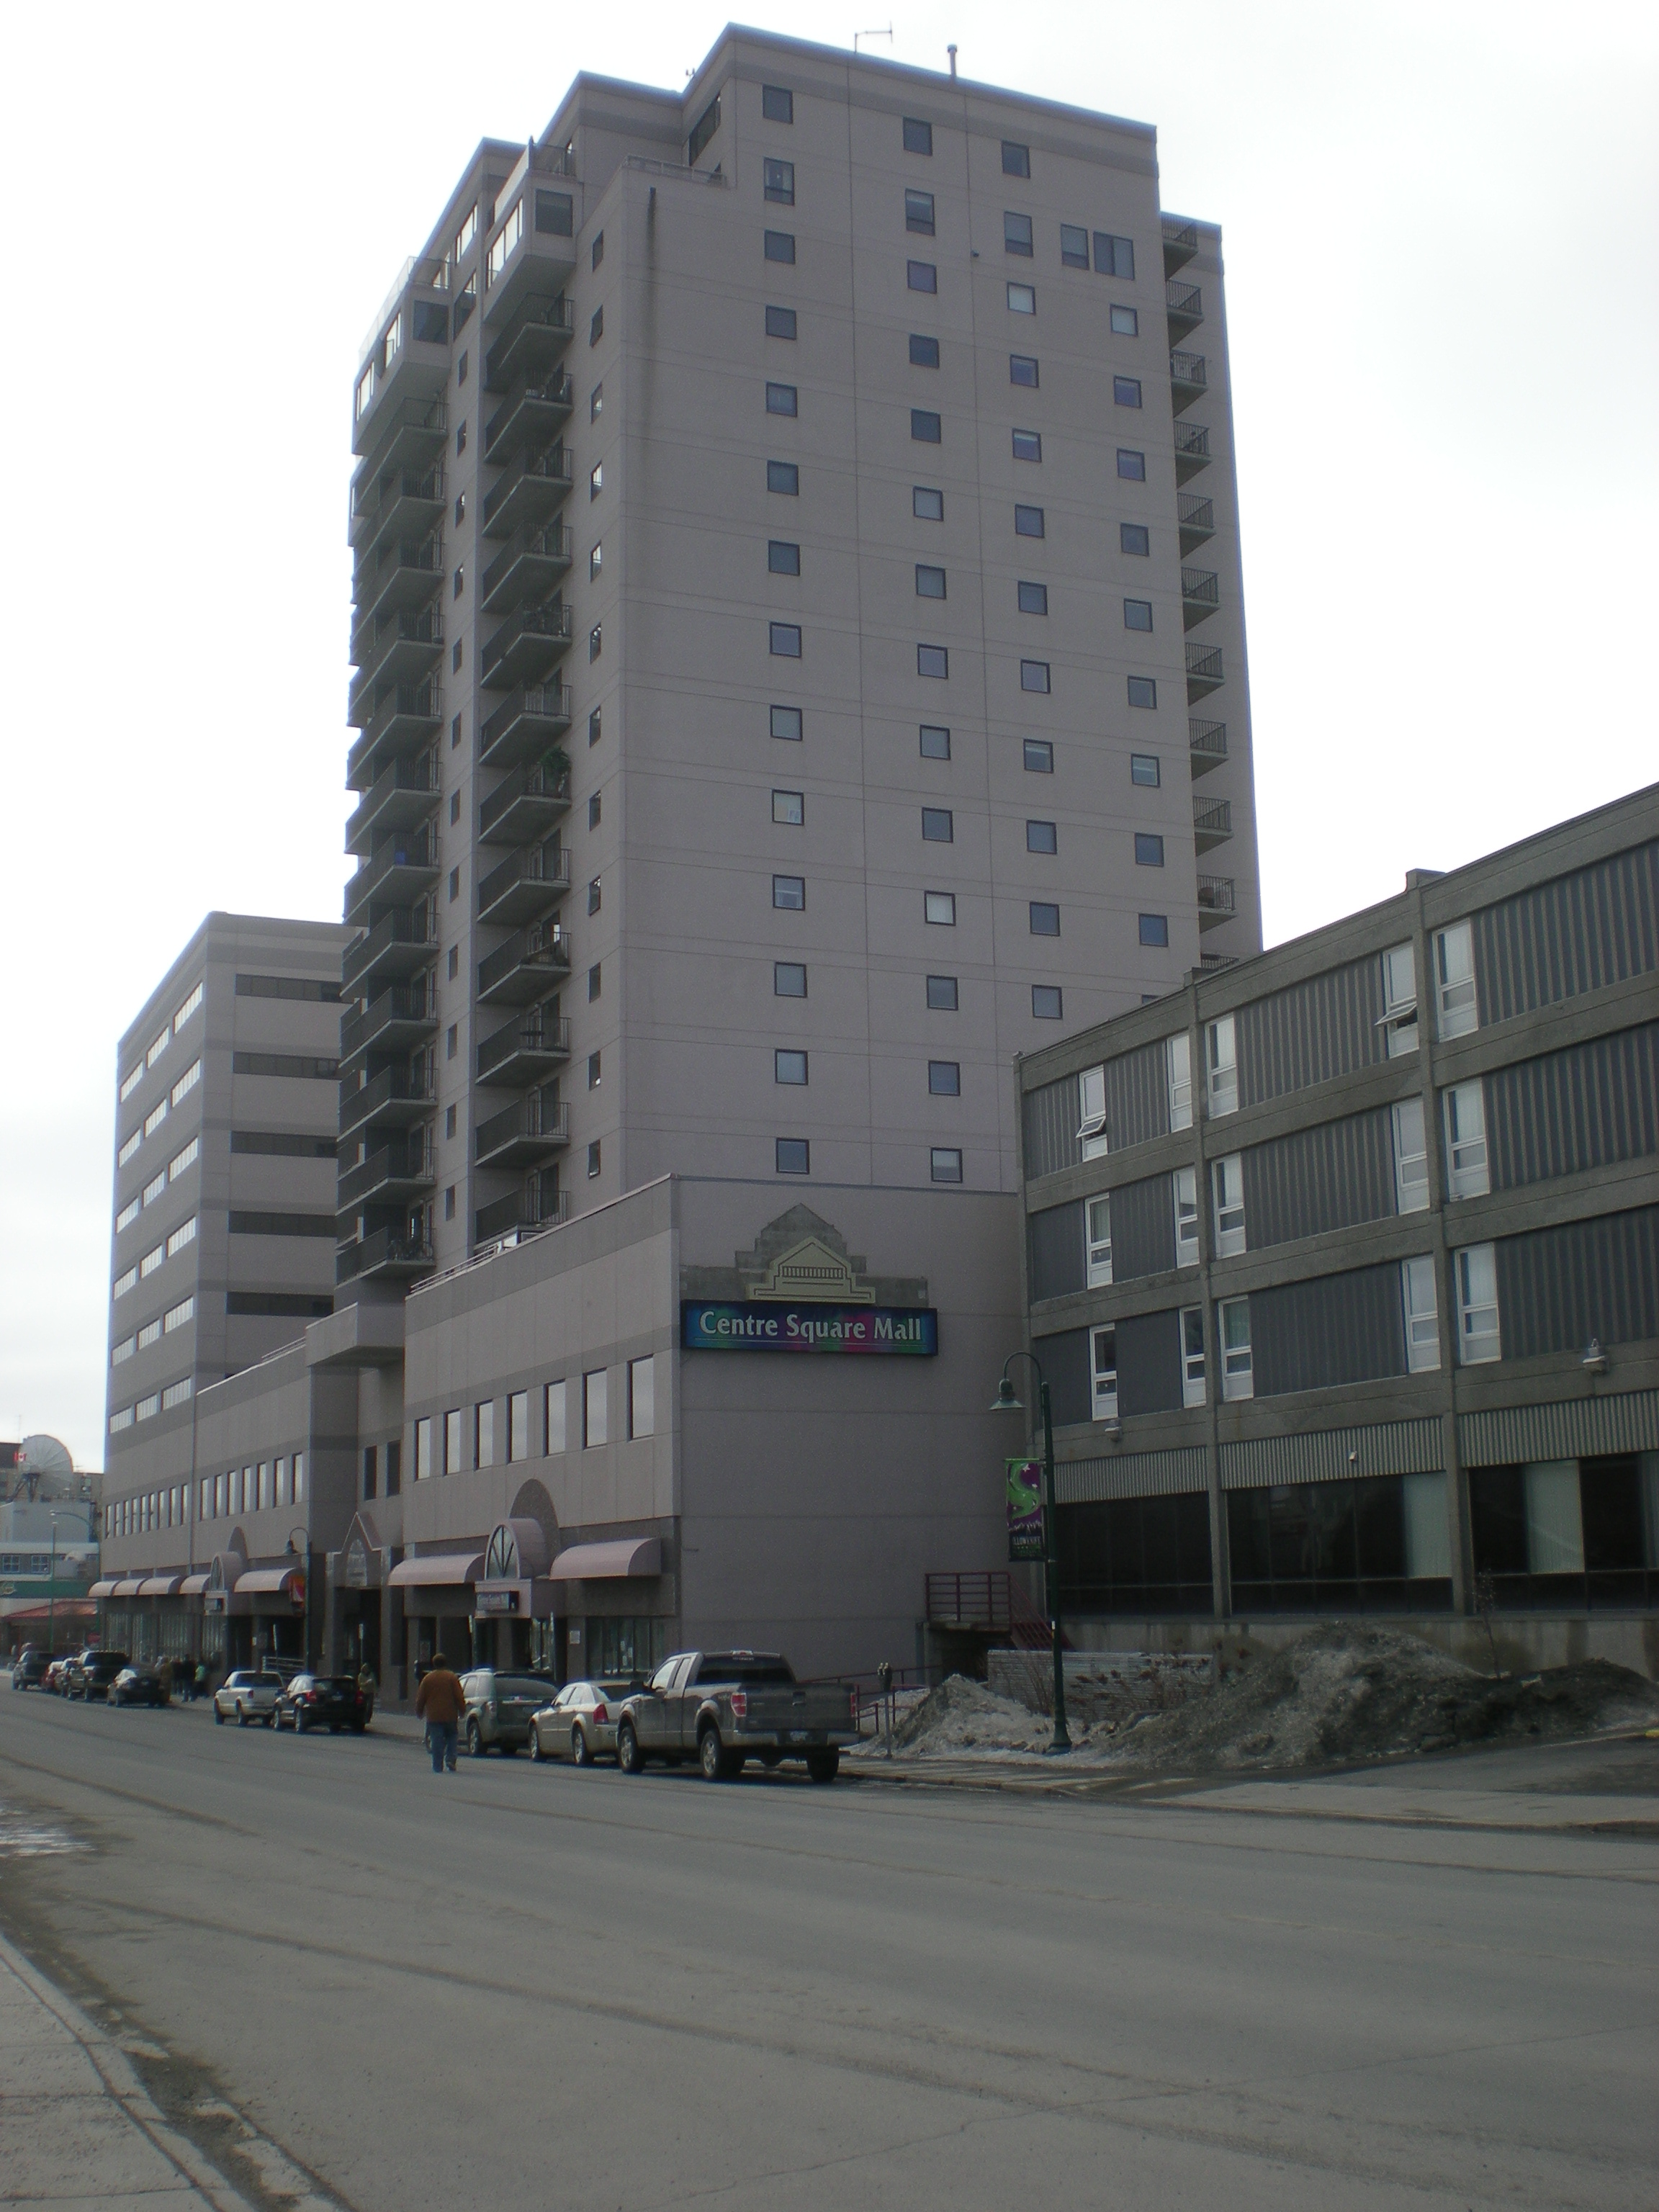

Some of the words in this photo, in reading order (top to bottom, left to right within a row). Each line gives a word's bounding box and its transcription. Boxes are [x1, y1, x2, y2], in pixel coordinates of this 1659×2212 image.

[699, 1311, 778, 1336] Centre
[786, 1313, 866, 1344] Square
[874, 1318, 922, 1341] Mall
